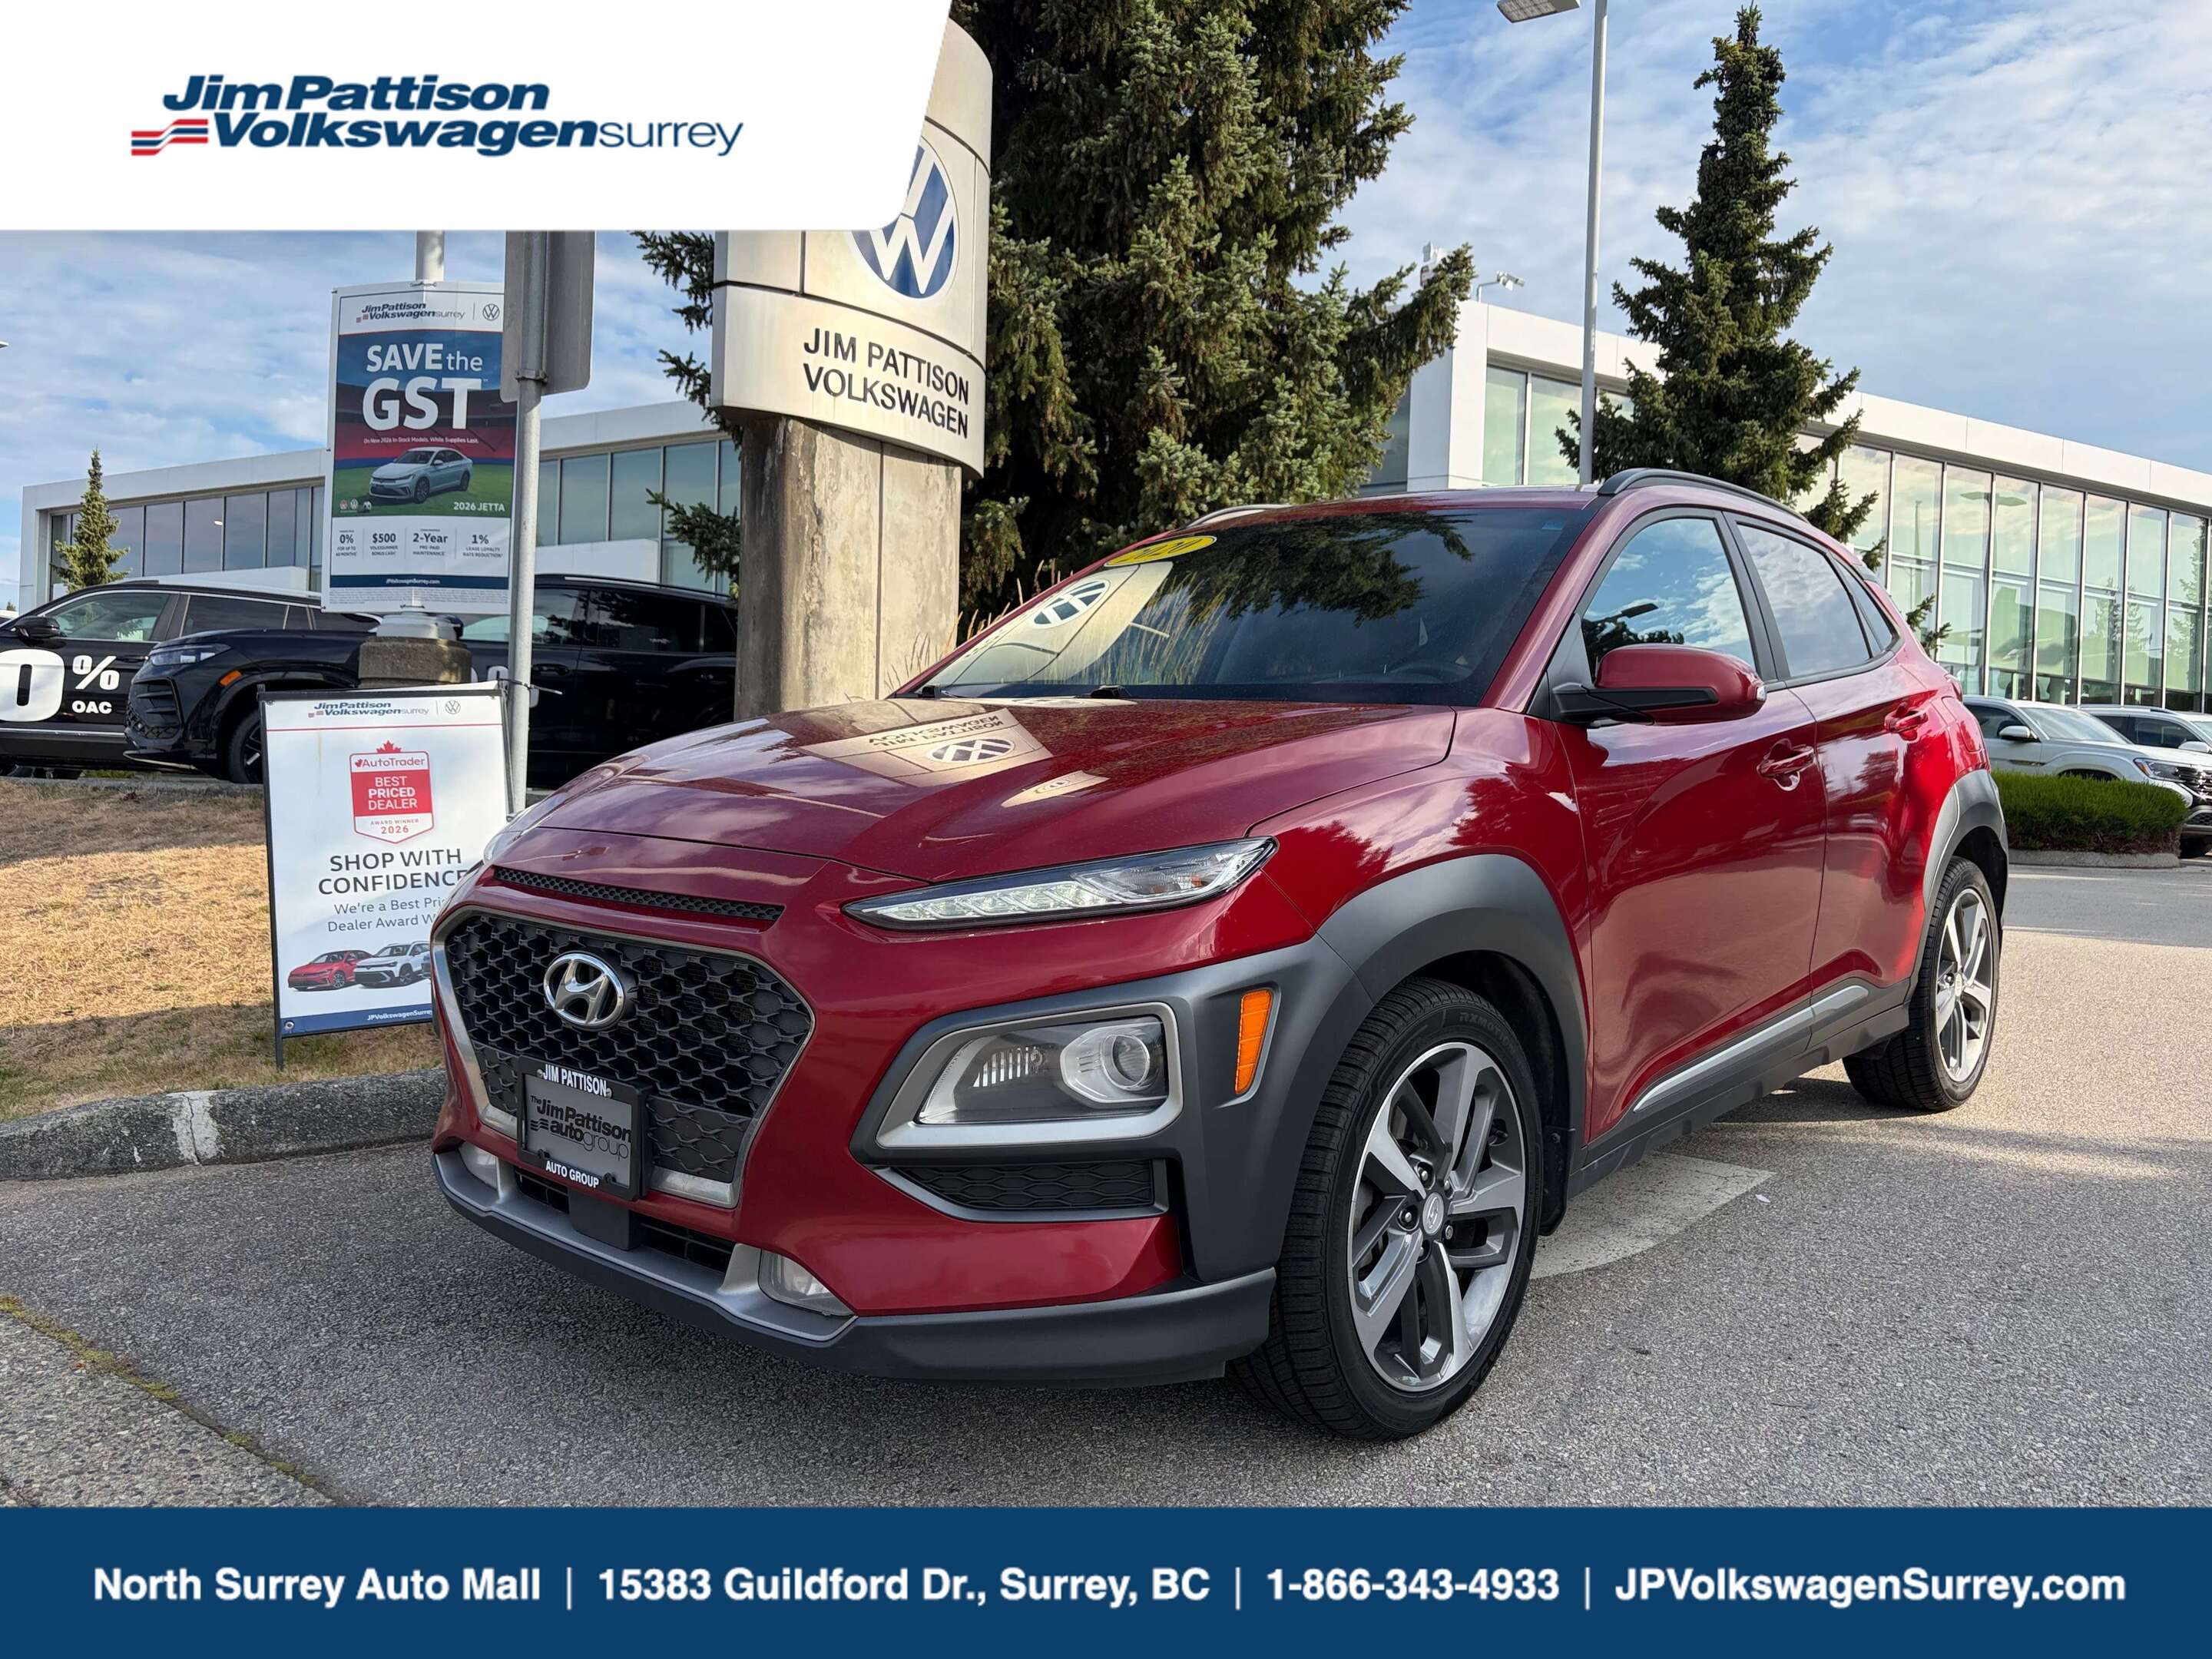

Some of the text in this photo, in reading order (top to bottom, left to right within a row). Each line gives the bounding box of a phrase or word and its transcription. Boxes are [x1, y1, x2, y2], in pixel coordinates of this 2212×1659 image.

[366, 343, 483, 373] SAVE the
[803, 328, 969, 406] JIM PATTISON
[363, 376, 482, 431] GST
[803, 363, 969, 439] VOLKSWAGEN
[453, 502, 505, 512] 2026 JETTA
[339, 534, 354, 544] 0%
[373, 532, 396, 544] $500
[413, 533, 448, 544] 2-Year
[472, 535, 489, 545] 1%
[71, 700, 113, 714] OAC
[363, 757, 426, 767] AutoTrader
[375, 776, 408, 788] BEST
[368, 787, 416, 799] PRICED
[368, 799, 418, 811] DEALER
[381, 825, 409, 835] 2026
[330, 848, 462, 872] SHOP WITH
[334, 901, 375, 915] We're
[378, 903, 386, 912] a
[390, 899, 419, 910] Best
[328, 919, 373, 932] Dealer
[376, 914, 419, 929] Award
[542, 1064, 607, 1097] JIM PATTISON
[530, 1094, 542, 1105] The
[545, 1160, 600, 1188] AUTO GROUP
